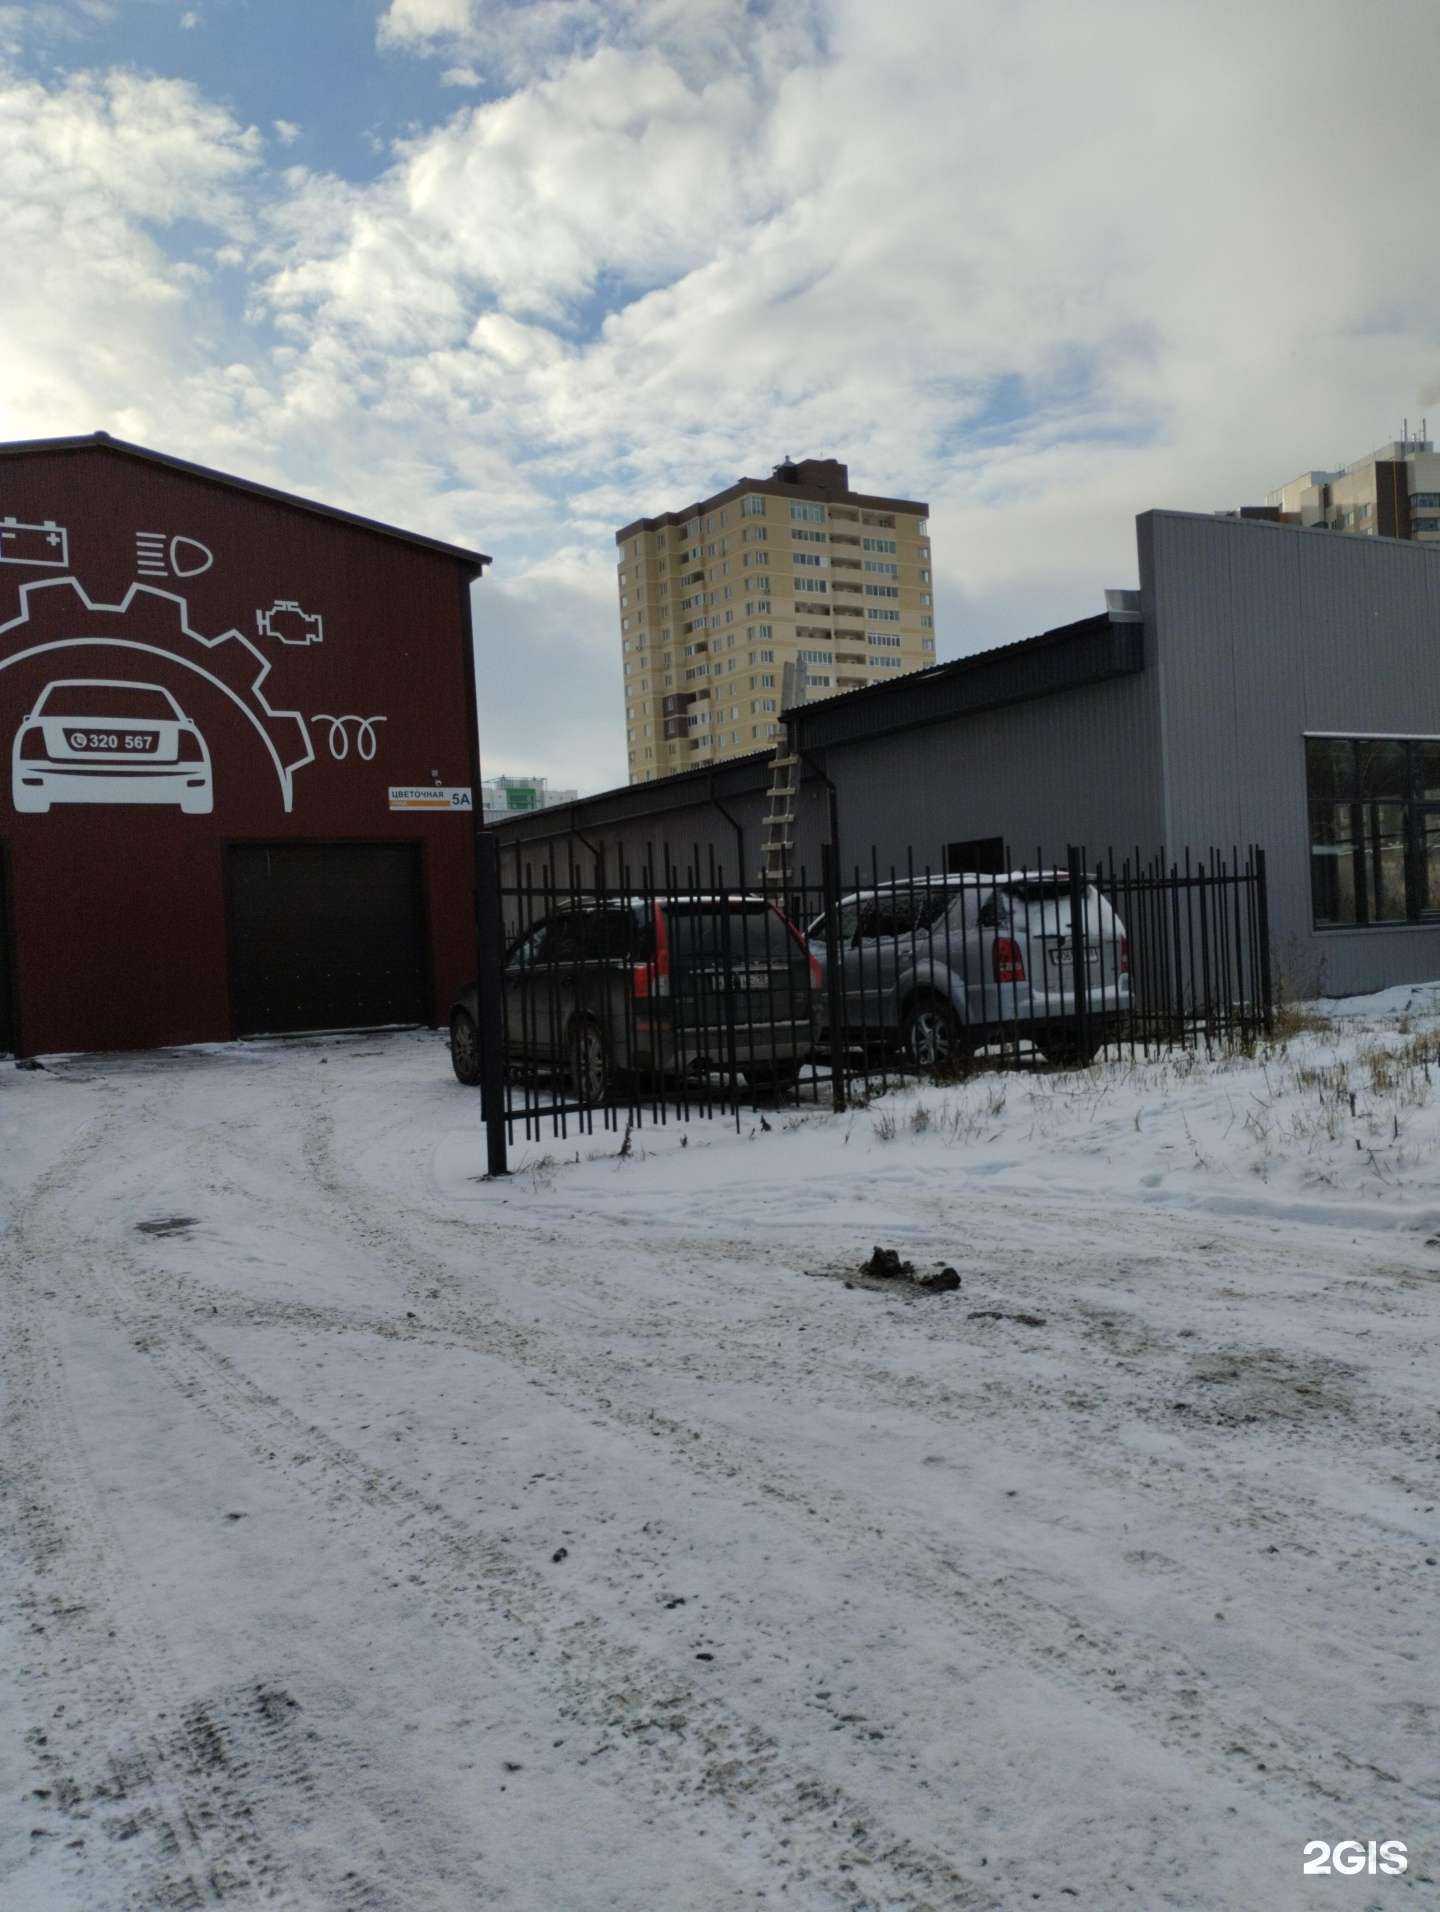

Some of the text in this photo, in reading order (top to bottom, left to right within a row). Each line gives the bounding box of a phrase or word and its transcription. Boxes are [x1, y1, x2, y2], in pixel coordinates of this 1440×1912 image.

[89, 735, 153, 750] 320 567
[392, 791, 444, 799] ЦВЕТОЧНАЯ
